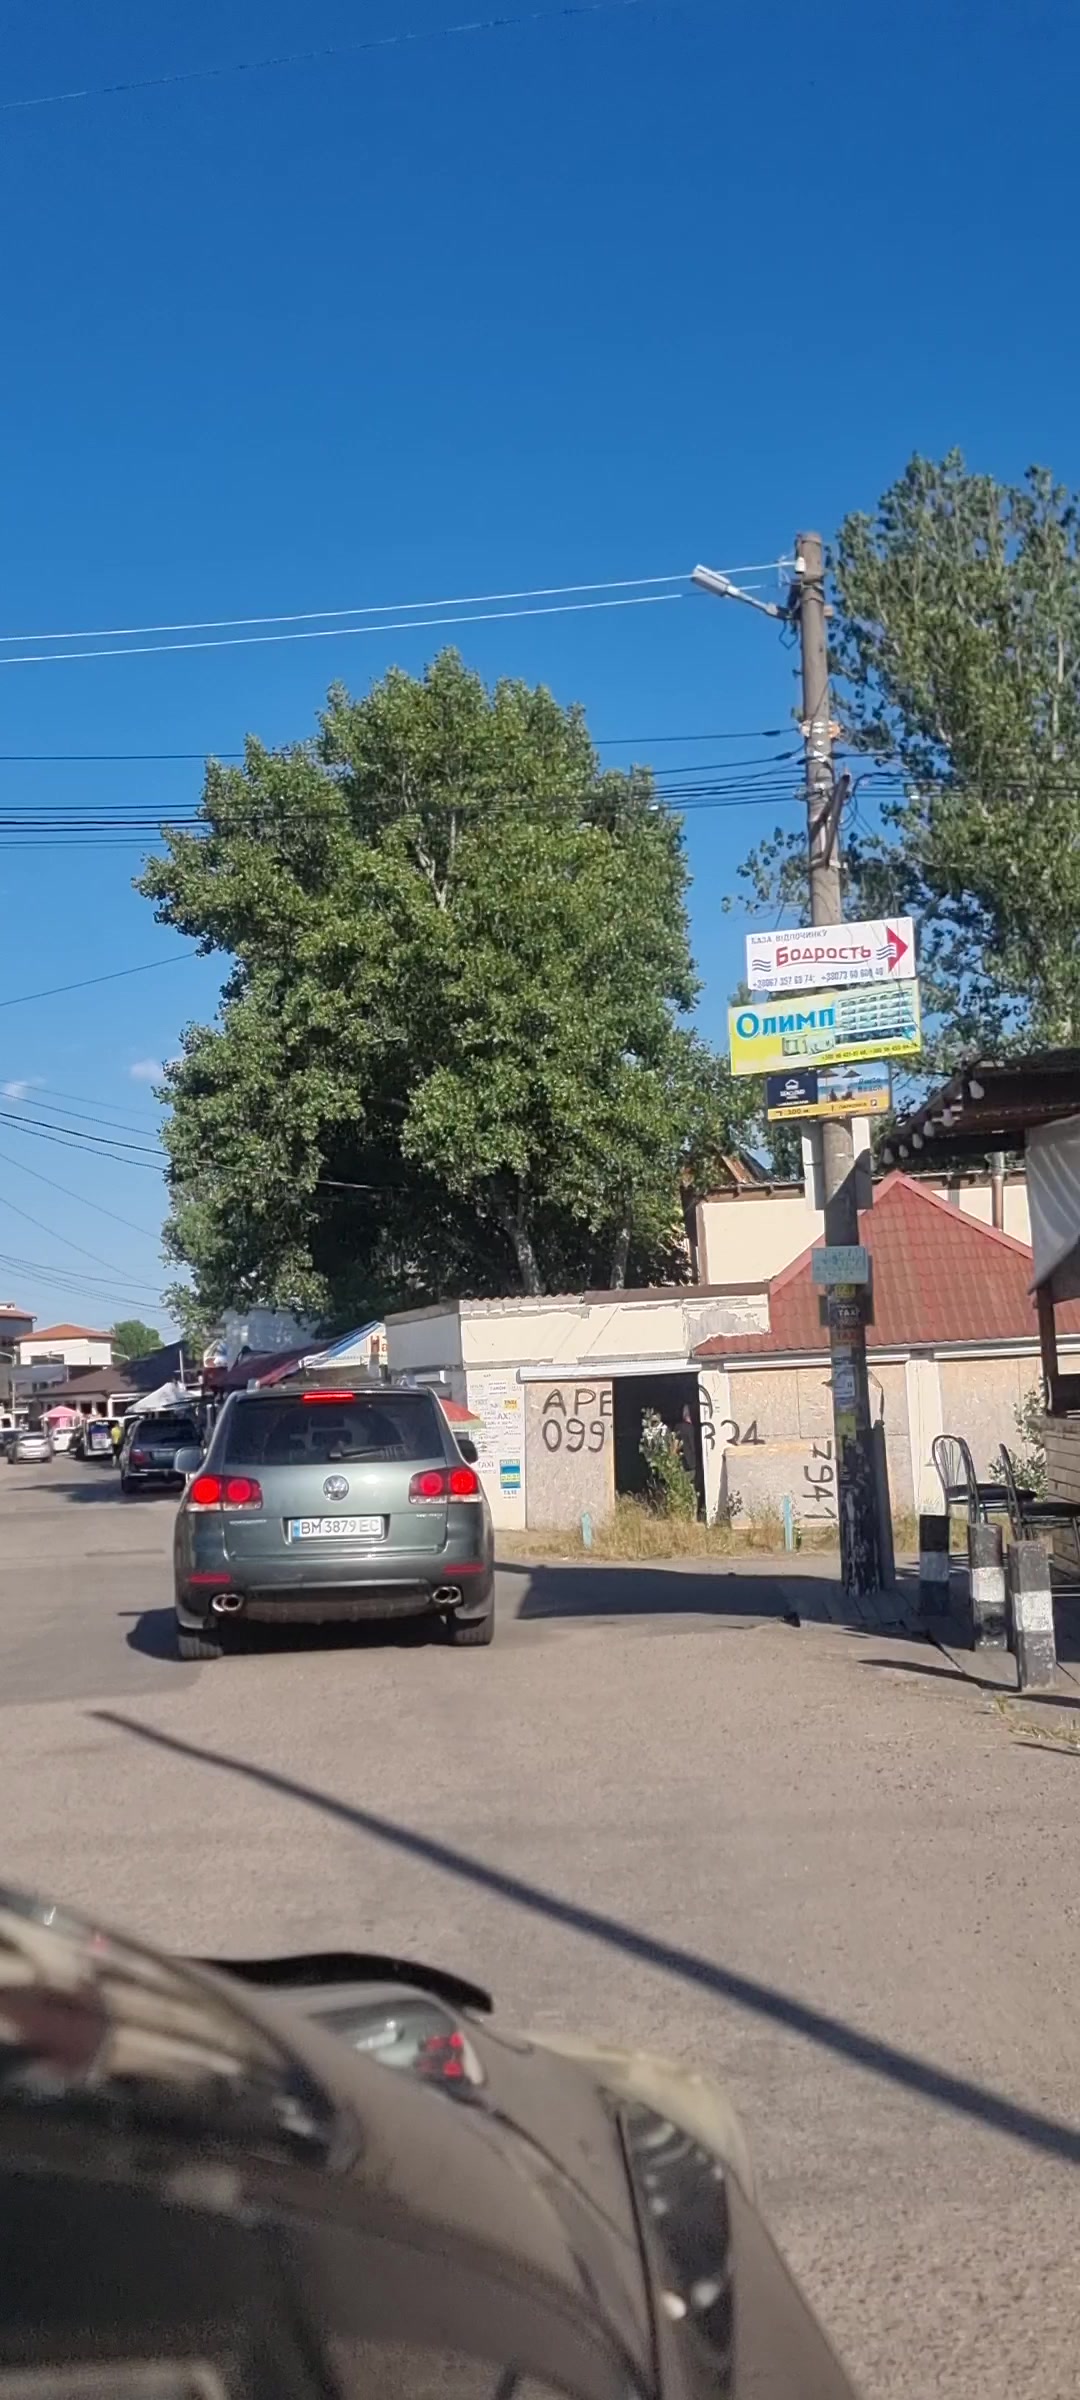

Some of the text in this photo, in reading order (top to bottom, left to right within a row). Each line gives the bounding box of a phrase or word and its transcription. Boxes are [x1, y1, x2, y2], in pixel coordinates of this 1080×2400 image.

[751, 929, 828, 944] БАЗА ВІДПОЧИНКУ
[776, 945, 872, 967] Бодрость
[736, 1007, 835, 1038] Олимп
[542, 1418, 605, 1453] 099
[803, 1440, 838, 1523] 7941
[301, 1519, 380, 1535] BM 3879 EC
